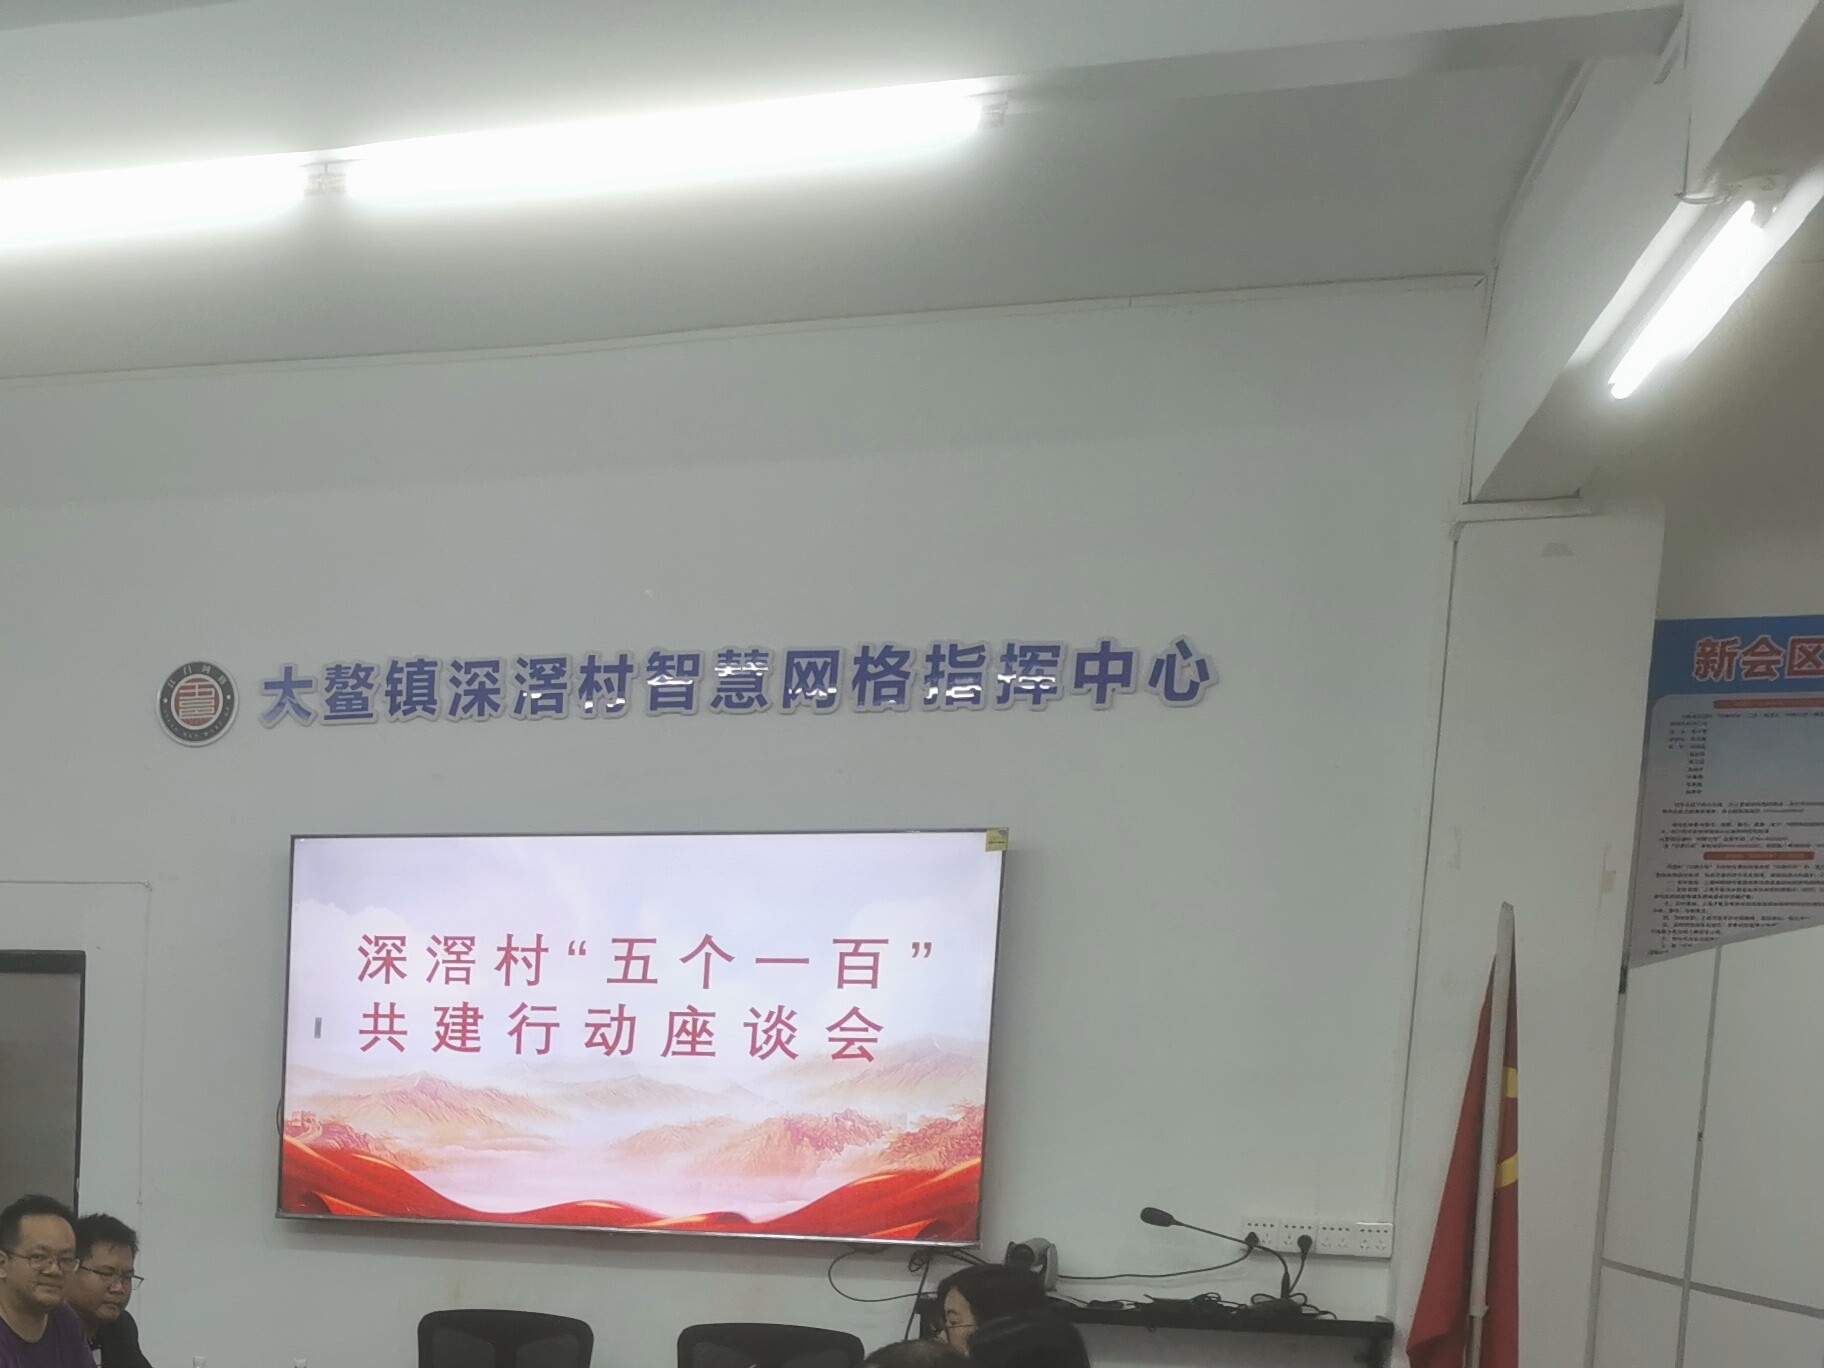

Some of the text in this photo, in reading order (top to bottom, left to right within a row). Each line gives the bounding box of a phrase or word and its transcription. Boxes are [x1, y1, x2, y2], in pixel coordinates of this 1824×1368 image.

[262, 640, 1210, 721] 大鳌镇深滘村智慧网格指挥中心
[1693, 636, 1824, 681] 新会区
[357, 933, 932, 989] 深滘村“五个一百”
[359, 1001, 883, 1061] 共建行动座谈会
